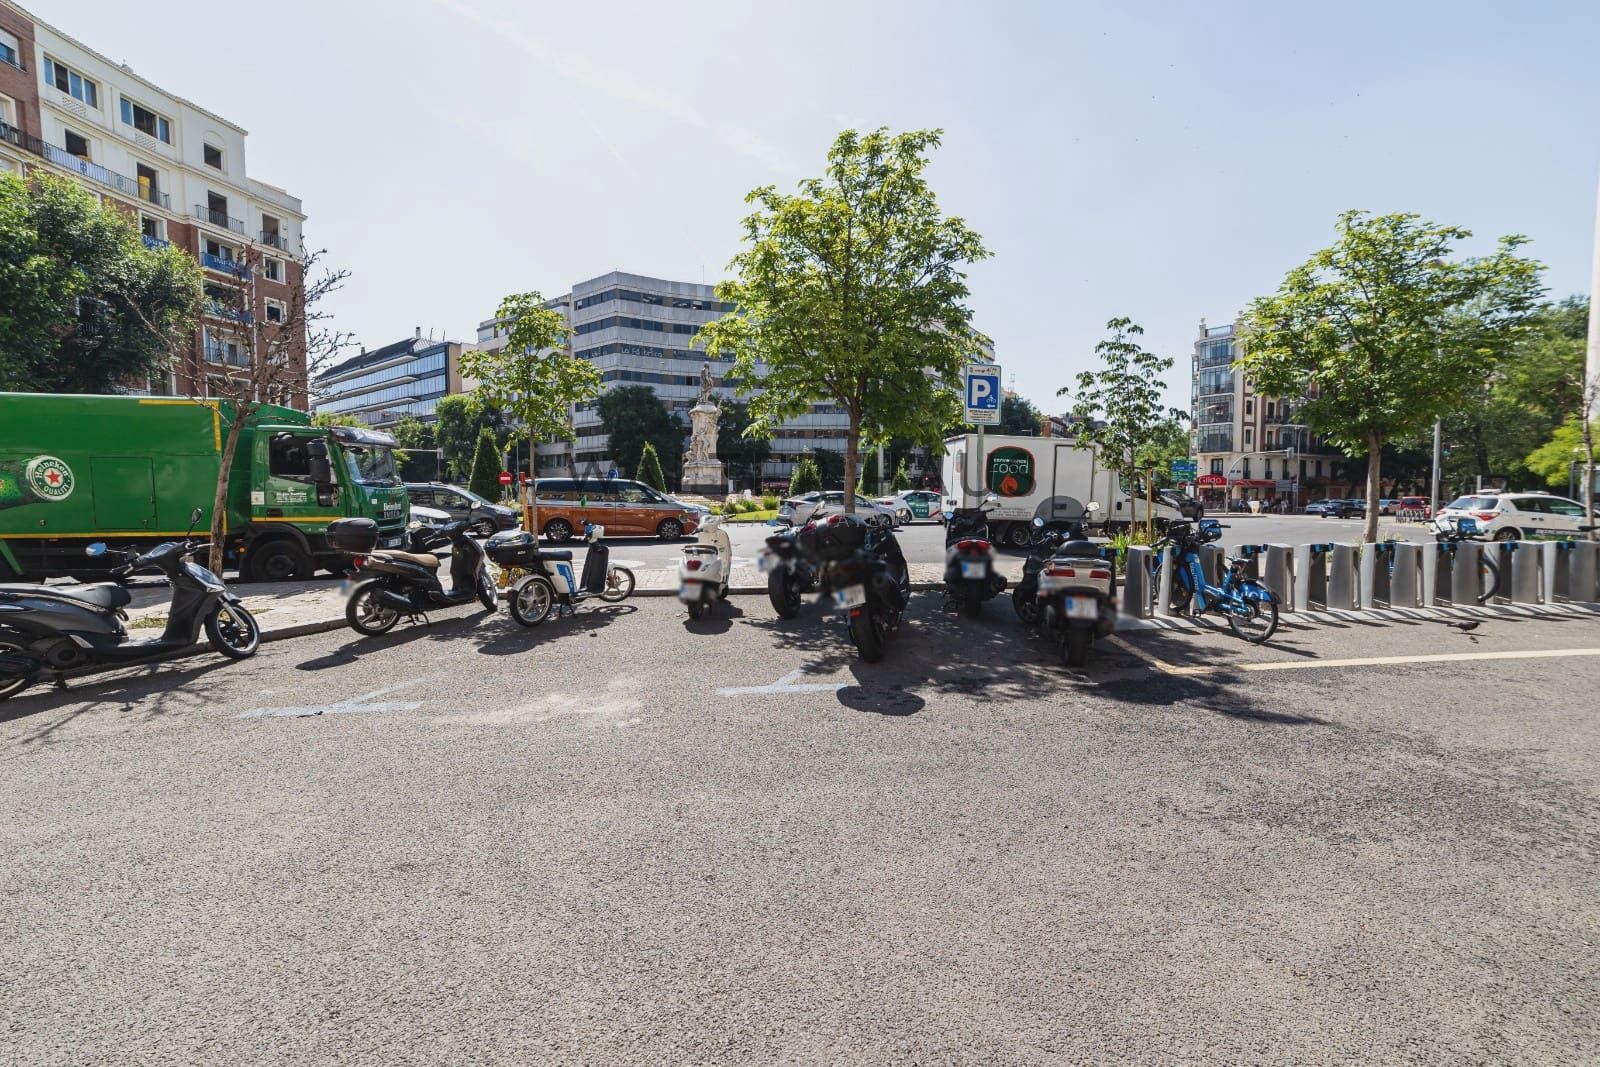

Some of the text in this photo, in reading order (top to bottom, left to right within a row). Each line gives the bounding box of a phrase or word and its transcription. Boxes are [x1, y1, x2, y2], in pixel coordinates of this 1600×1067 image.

[972, 379, 991, 406] P
[35, 461, 69, 479] Heineken
[43, 482, 70, 496] QUALITY
